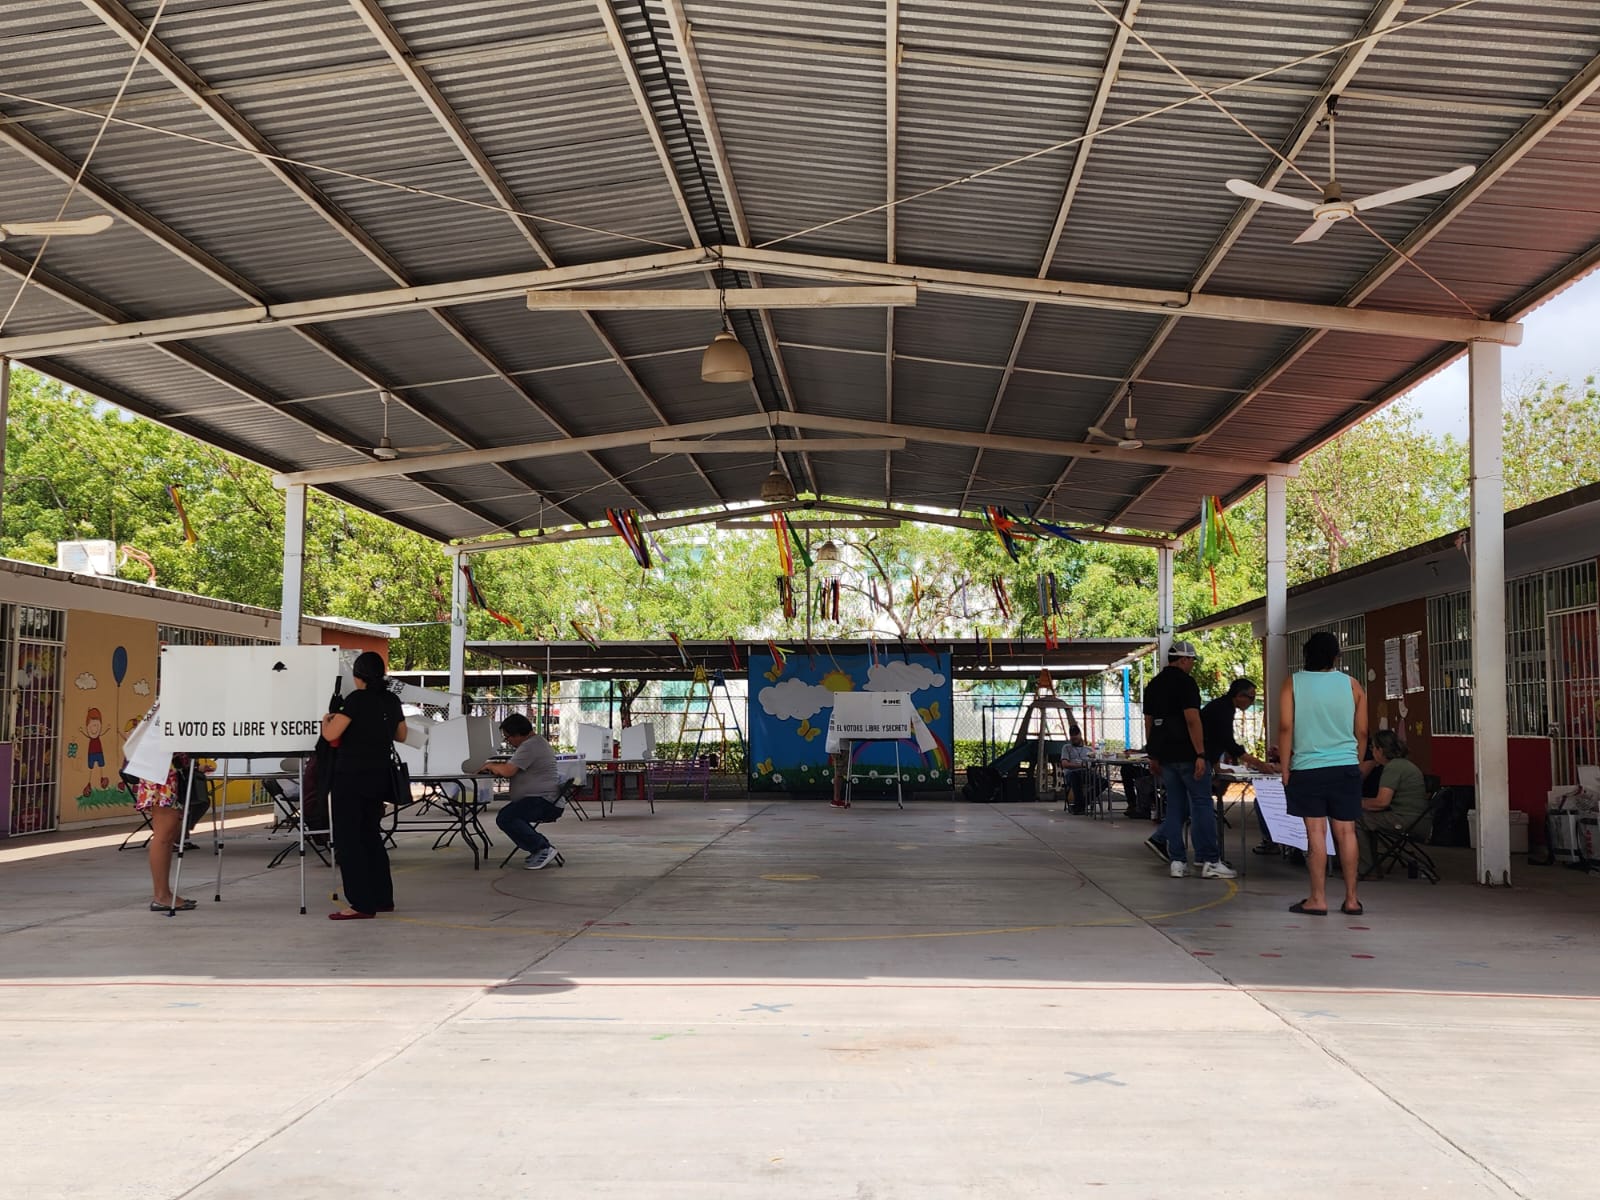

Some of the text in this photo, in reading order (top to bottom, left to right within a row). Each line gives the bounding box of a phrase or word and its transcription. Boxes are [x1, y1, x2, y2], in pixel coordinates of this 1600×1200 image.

[164, 721, 175, 737] EL
[178, 721, 208, 737] VOTO
[212, 721, 226, 737] ES
[233, 721, 265, 736] LIBRE
[270, 720, 278, 736] Y
[281, 720, 323, 736] SECRET
[837, 724, 842, 732] EL
[865, 724, 880, 732] LIBRE
[886, 724, 908, 732] SECRETO
